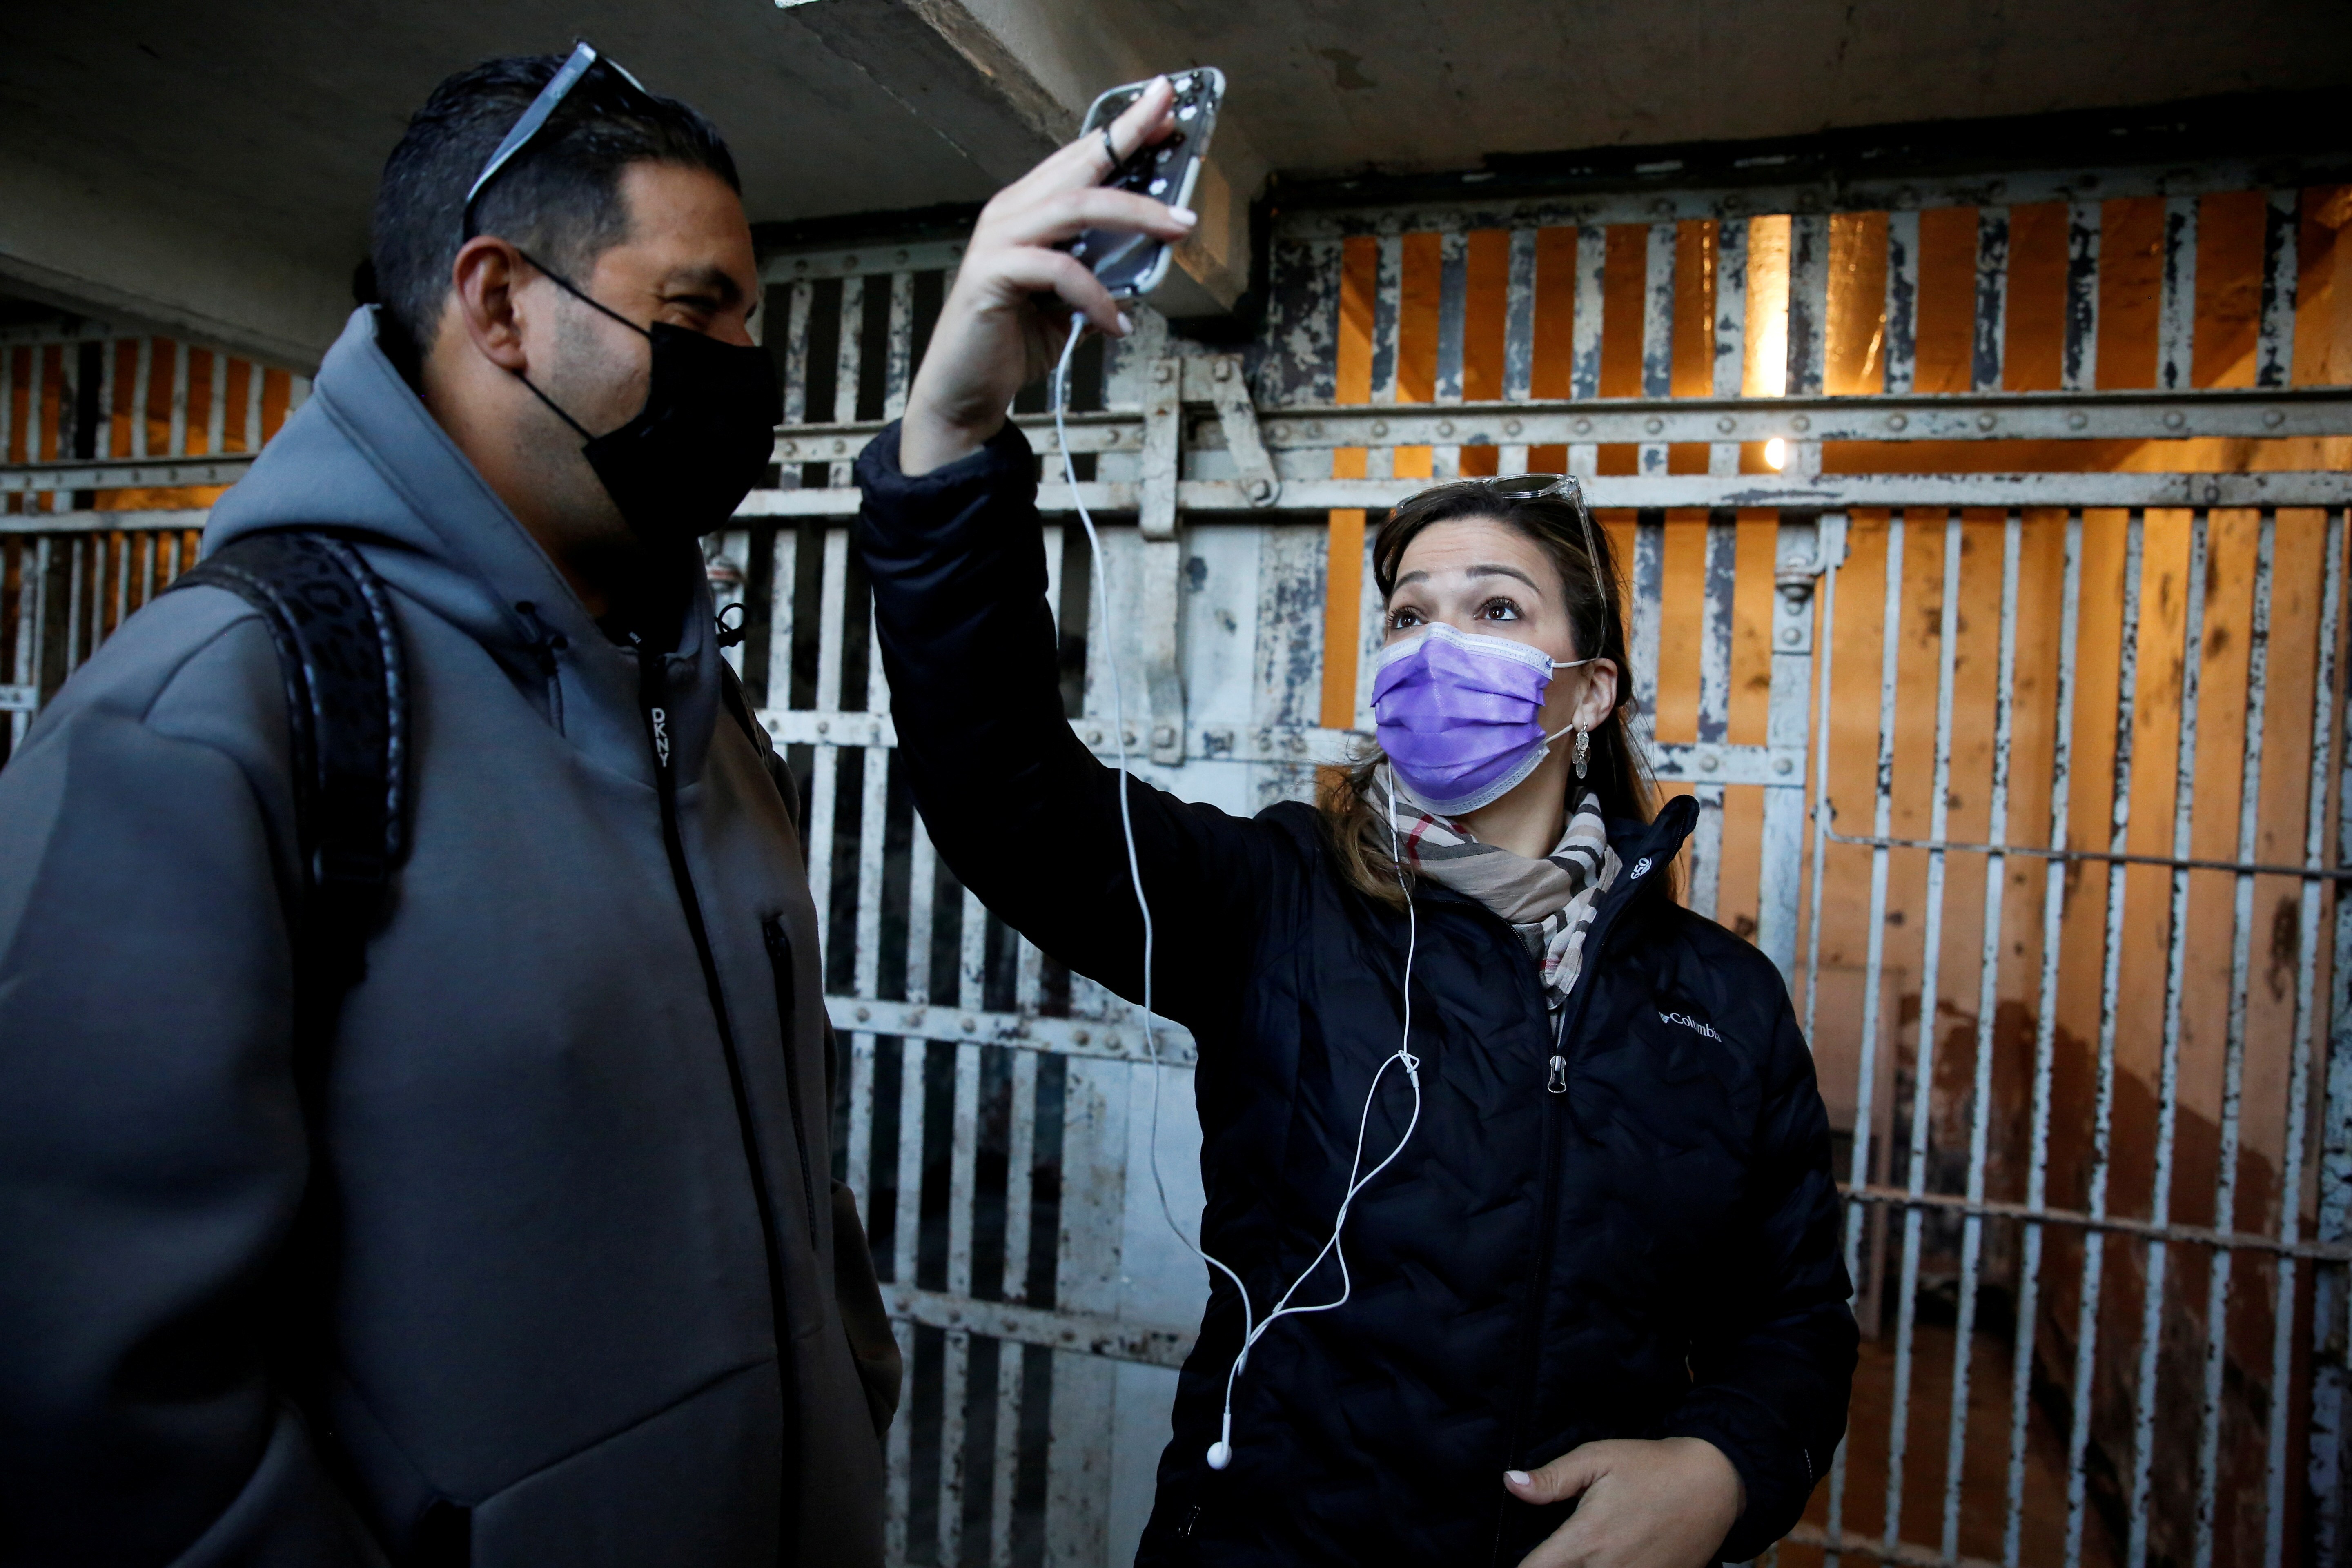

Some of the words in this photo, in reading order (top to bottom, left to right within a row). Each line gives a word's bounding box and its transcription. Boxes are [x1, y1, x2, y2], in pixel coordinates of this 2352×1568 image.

[652, 708, 670, 767] DKNY
[1630, 858, 1650, 879] 650
[1670, 1013, 1722, 1042] Columbia
